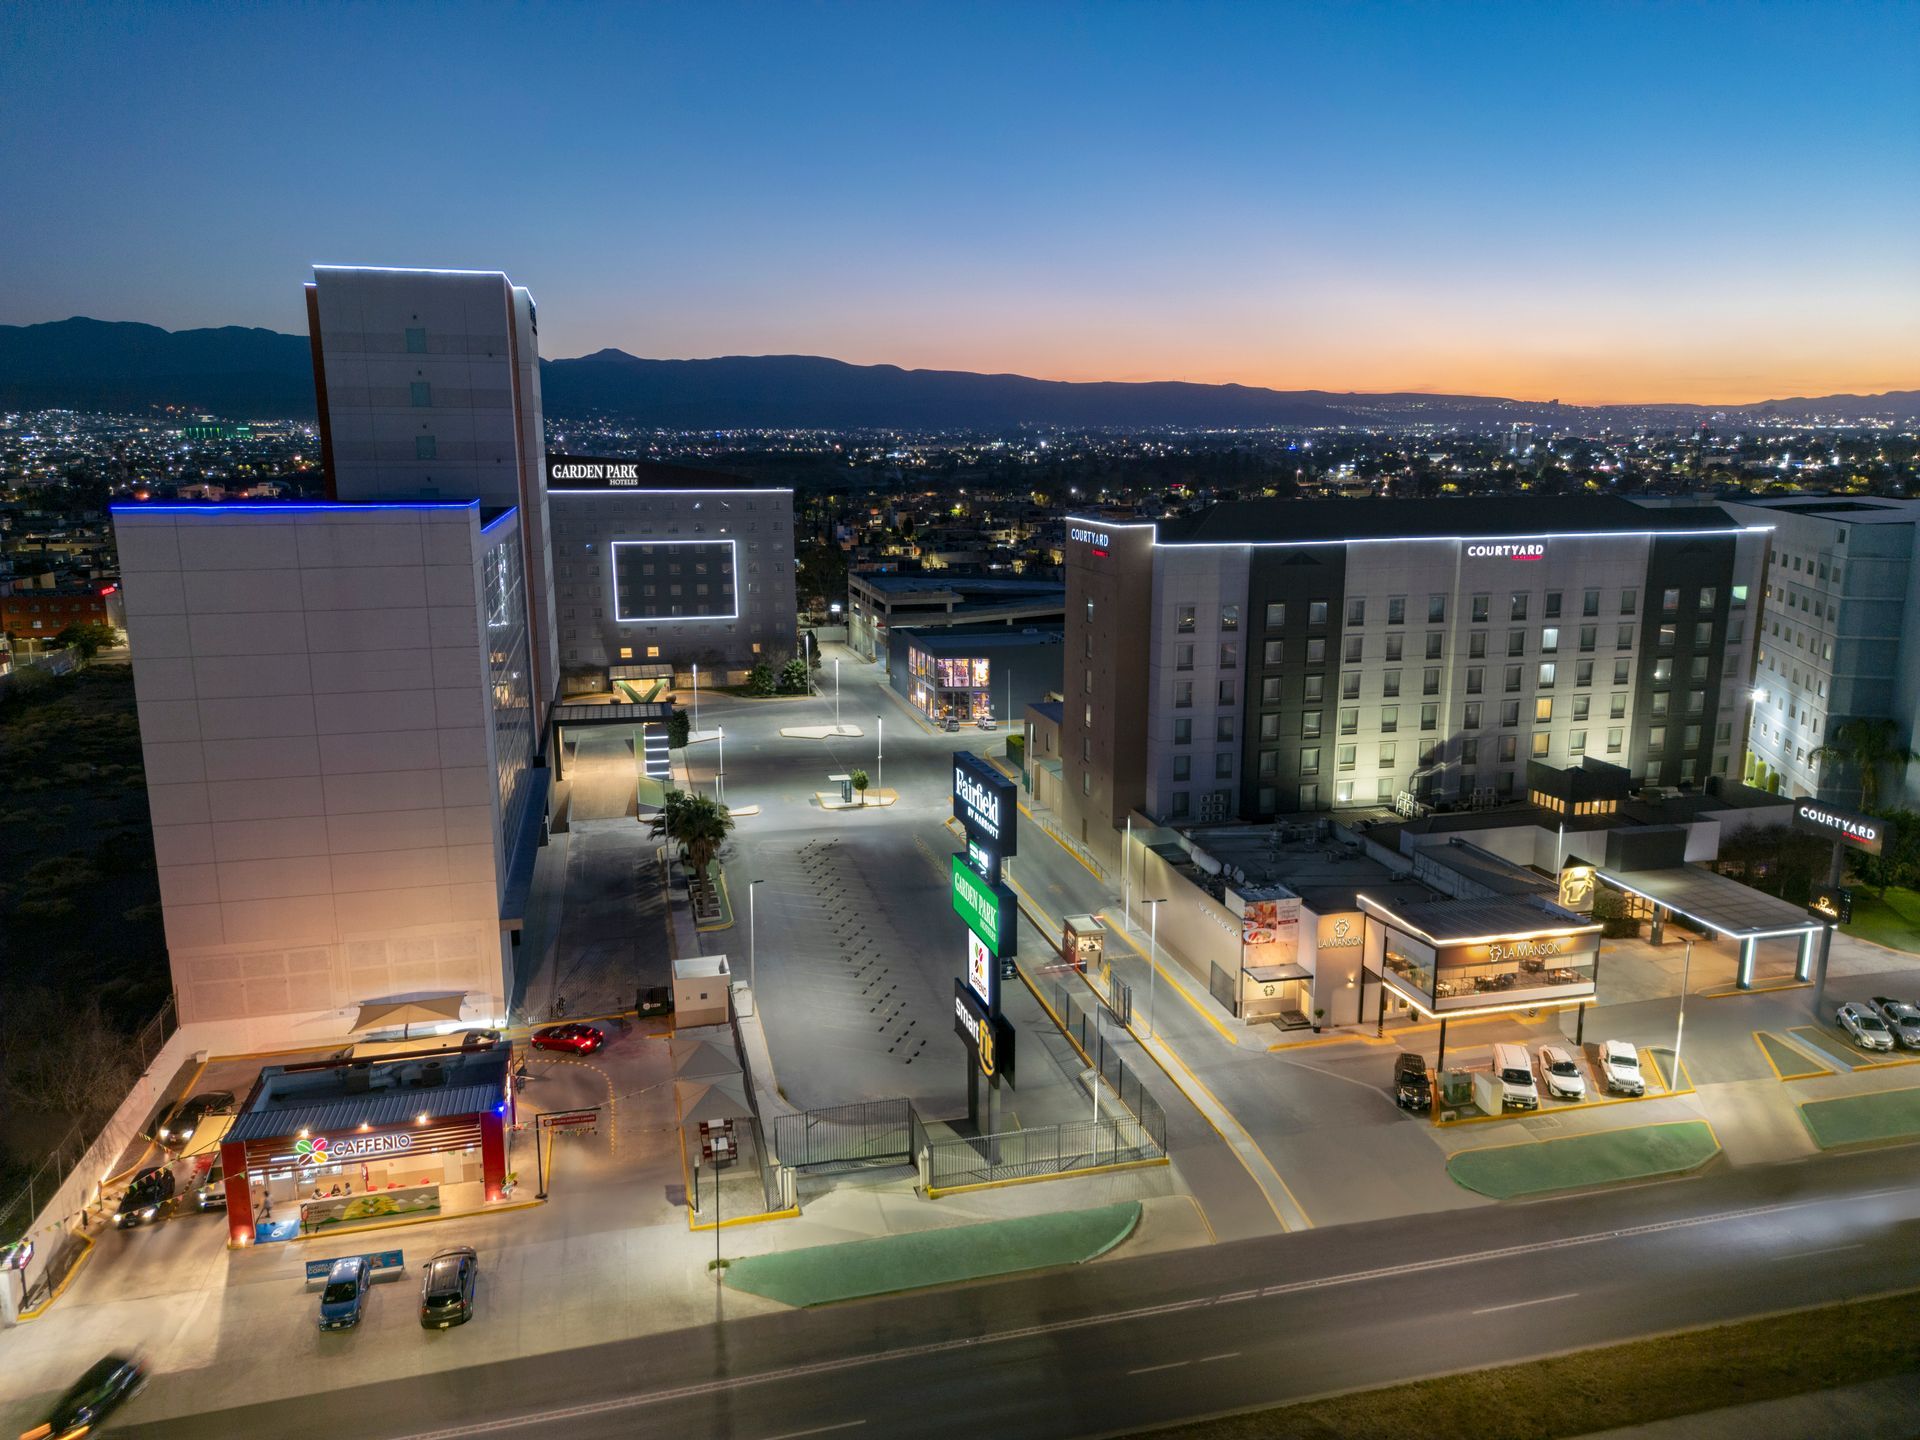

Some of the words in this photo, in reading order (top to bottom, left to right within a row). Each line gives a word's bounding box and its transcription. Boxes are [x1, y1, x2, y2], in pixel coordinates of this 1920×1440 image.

[552, 464, 603, 478] GARDEN
[606, 464, 638, 478] PARK
[1071, 528, 1109, 547] COURTYARD
[1467, 545, 1544, 556] COURTYARD
[956, 767, 999, 827] Fairfield
[967, 806, 975, 818] BY
[975, 813, 999, 840] MARRIOTT
[1800, 807, 1876, 840] COURTYARD
[954, 872, 978, 911] GARDEN
[978, 894, 997, 932] PARK
[1318, 938, 1328, 949] LA
[1503, 946, 1515, 959] LA
[333, 1134, 411, 1156] CAFFENIO
